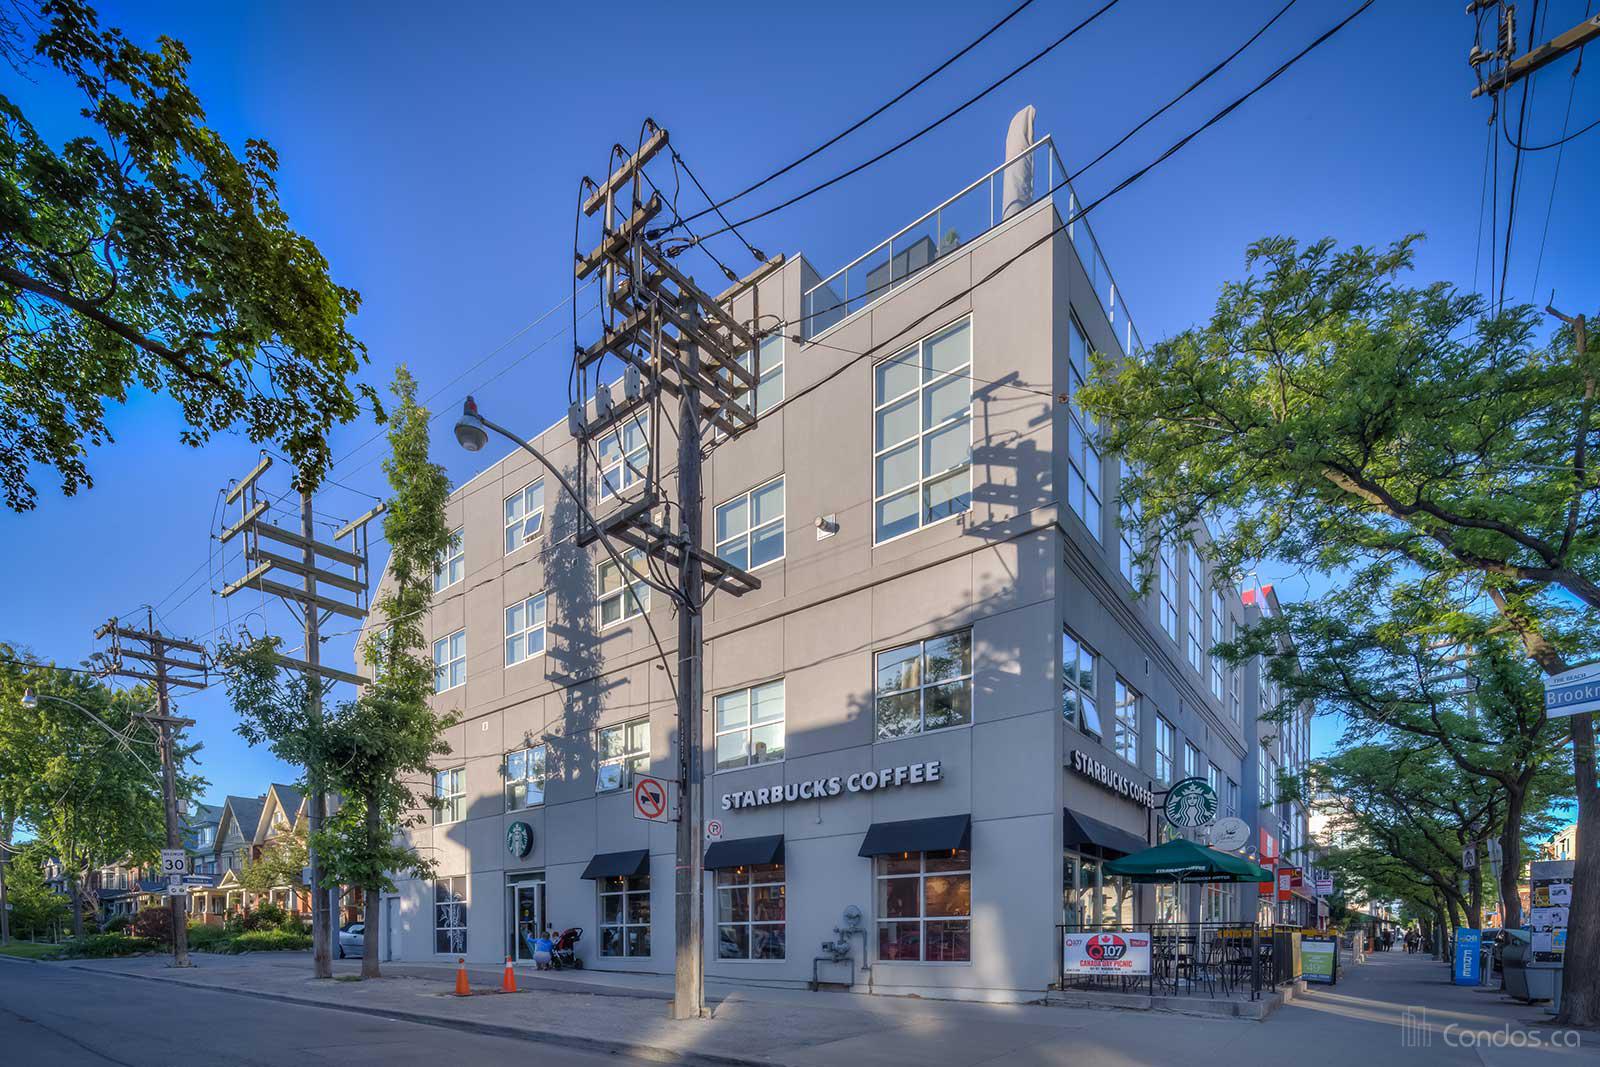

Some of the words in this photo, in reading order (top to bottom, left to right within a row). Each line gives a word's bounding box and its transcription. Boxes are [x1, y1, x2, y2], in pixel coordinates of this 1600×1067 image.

[721, 776, 842, 811] STARBUCKS
[847, 760, 942, 793] COFFEE
[1074, 749, 1128, 796] STARBUCKS
[1129, 780, 1155, 809] COFFEE
[165, 859, 184, 870] 30
